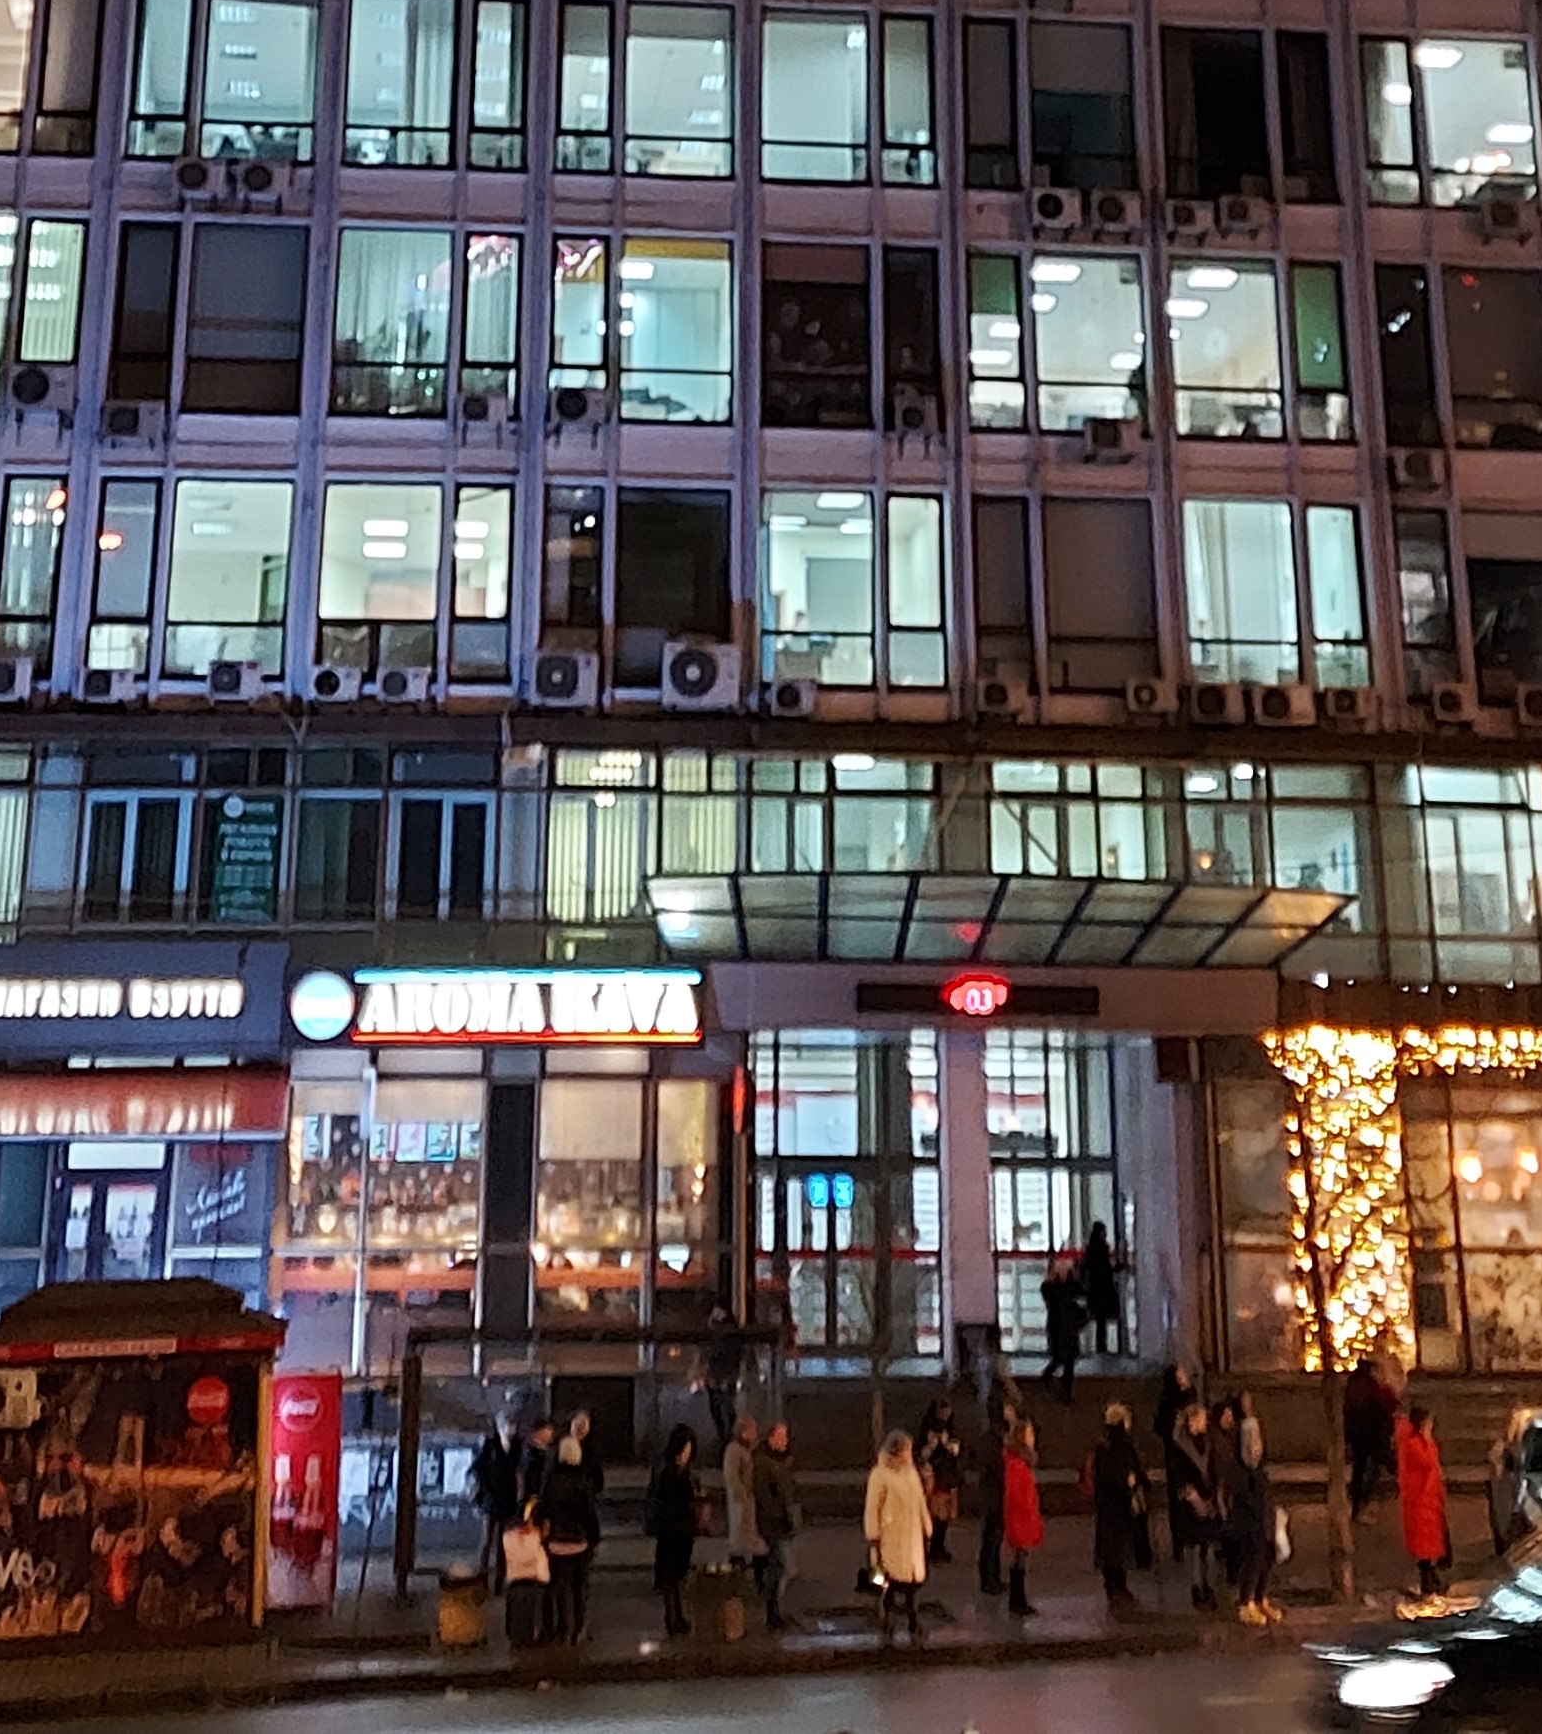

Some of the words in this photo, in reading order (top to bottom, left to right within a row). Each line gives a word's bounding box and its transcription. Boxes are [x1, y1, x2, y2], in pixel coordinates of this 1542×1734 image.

[128, 977, 244, 1018] ВЗУТТЯ
[359, 982, 547, 1033] AROMA
[551, 982, 699, 1033] KAVA
